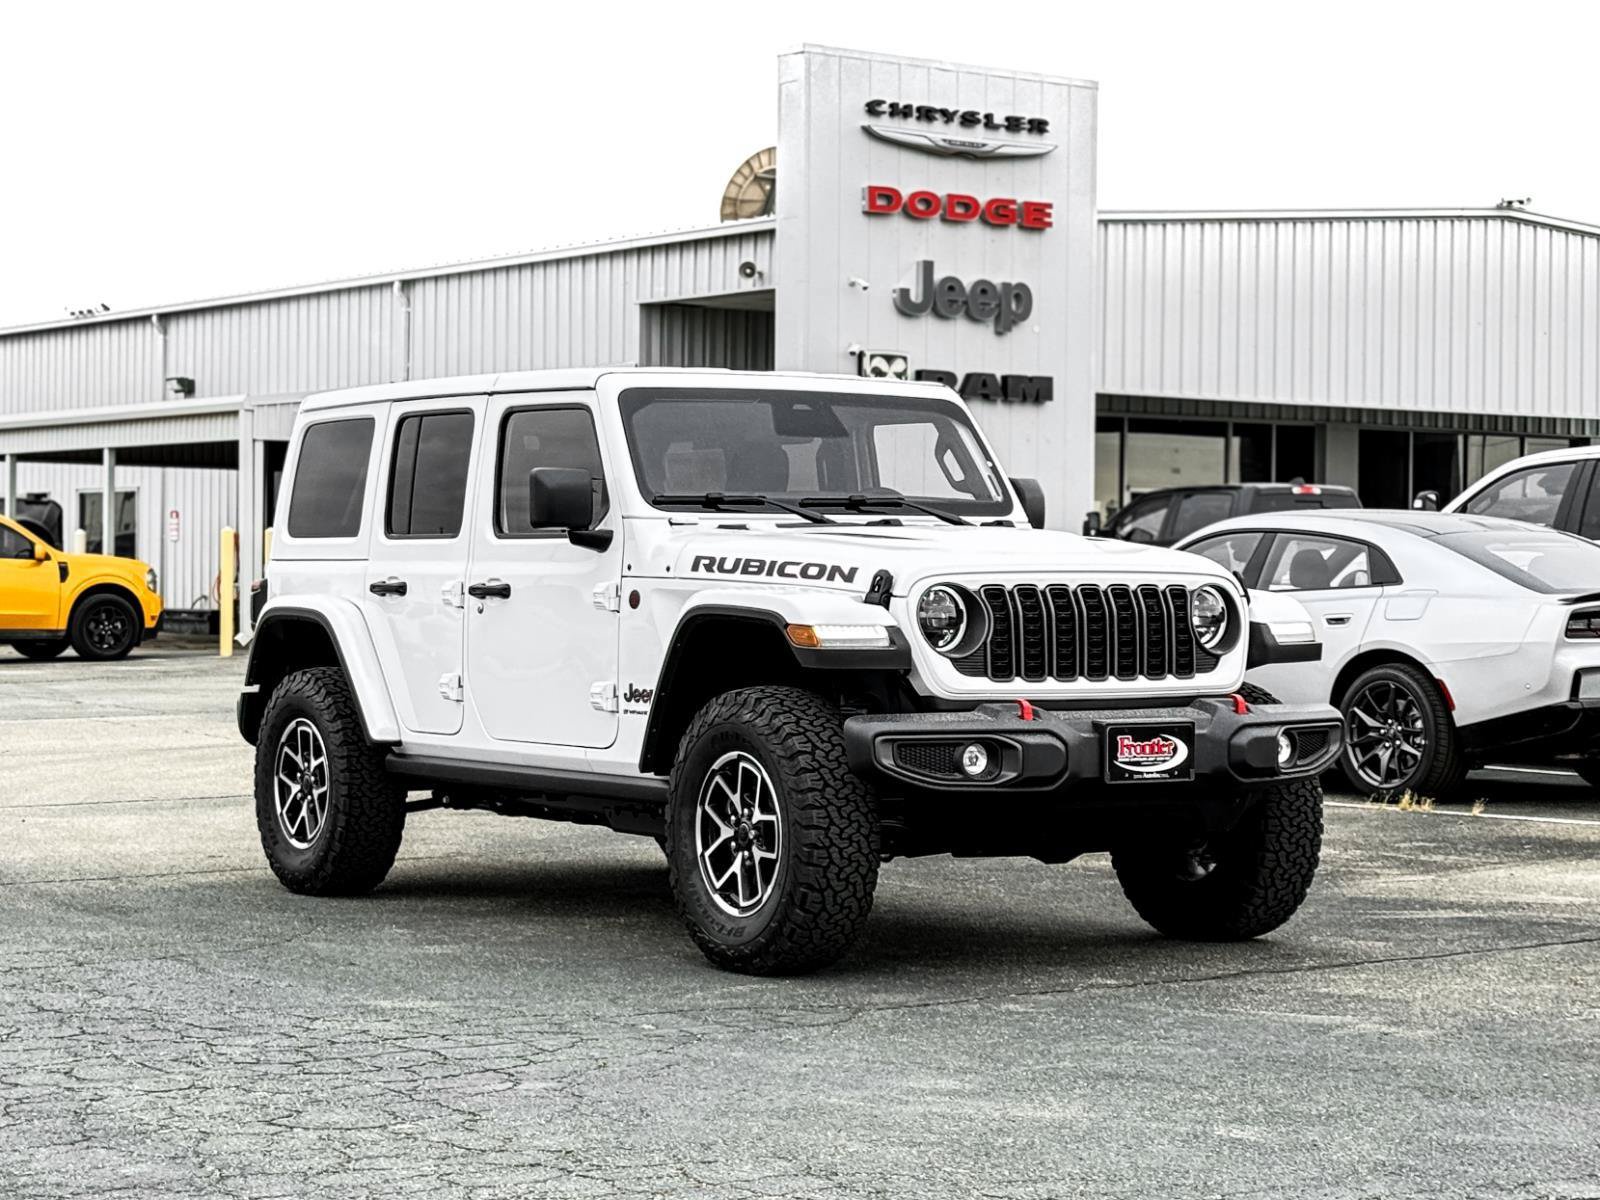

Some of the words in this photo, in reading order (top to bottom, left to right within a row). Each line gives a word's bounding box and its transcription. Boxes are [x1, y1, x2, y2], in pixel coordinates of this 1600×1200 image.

[865, 99, 1050, 134] CHRYSLER
[863, 185, 1054, 230] DODGE
[893, 260, 1033, 335] Jeep
[690, 555, 859, 583] RUBICON
[1117, 735, 1174, 757] Frontier
